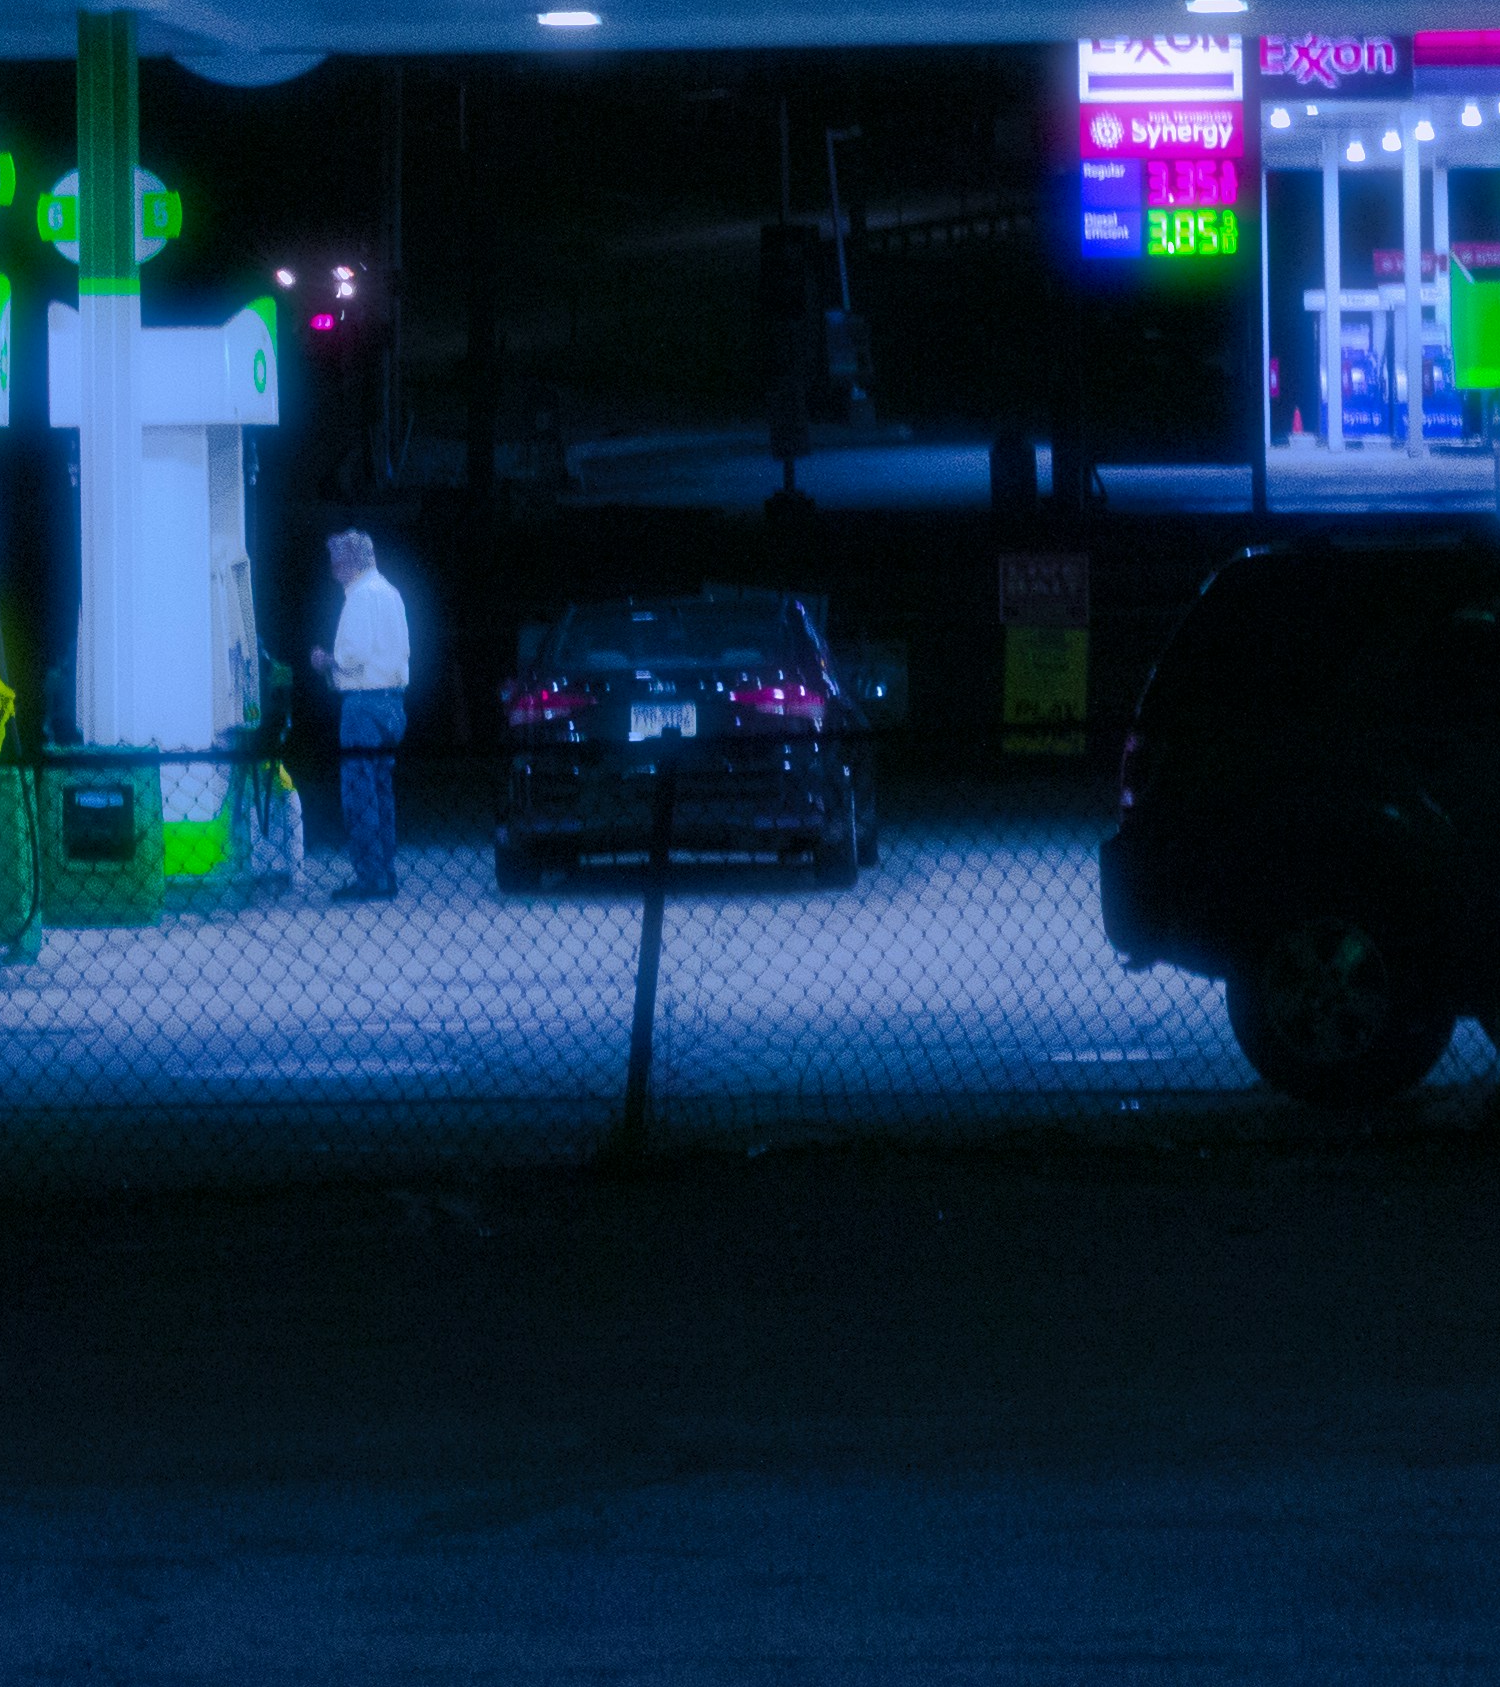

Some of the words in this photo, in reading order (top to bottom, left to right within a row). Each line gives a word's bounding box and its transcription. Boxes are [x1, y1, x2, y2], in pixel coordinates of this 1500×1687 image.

[1259, 32, 1397, 89] Exxon
[1131, 117, 1234, 150] Synergy
[1082, 161, 1126, 181] Regular
